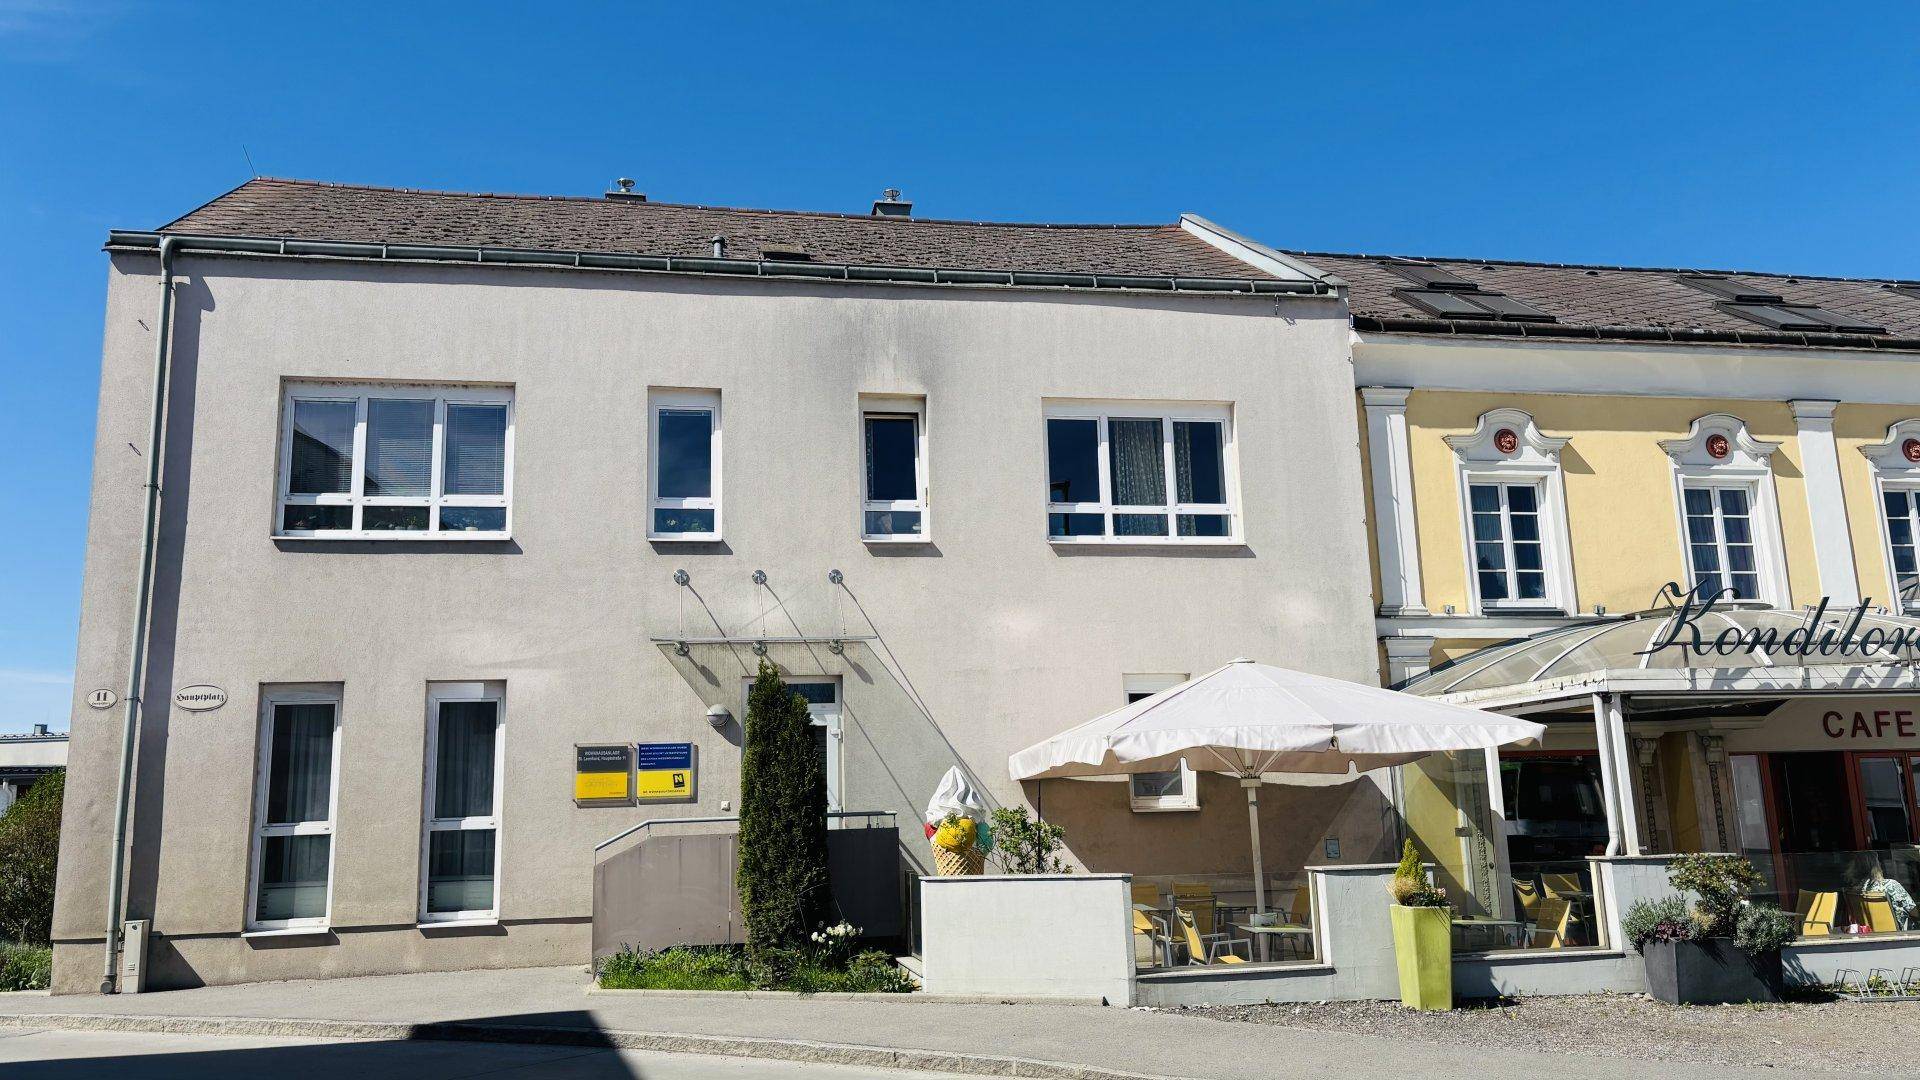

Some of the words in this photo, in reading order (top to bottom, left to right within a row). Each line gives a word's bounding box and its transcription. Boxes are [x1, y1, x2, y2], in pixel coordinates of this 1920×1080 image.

[1633, 579, 1920, 656] Konditor
[96, 692, 107, 701] 11
[176, 691, 224, 702] Hauptplatz
[1822, 710, 1917, 738] CAFE
